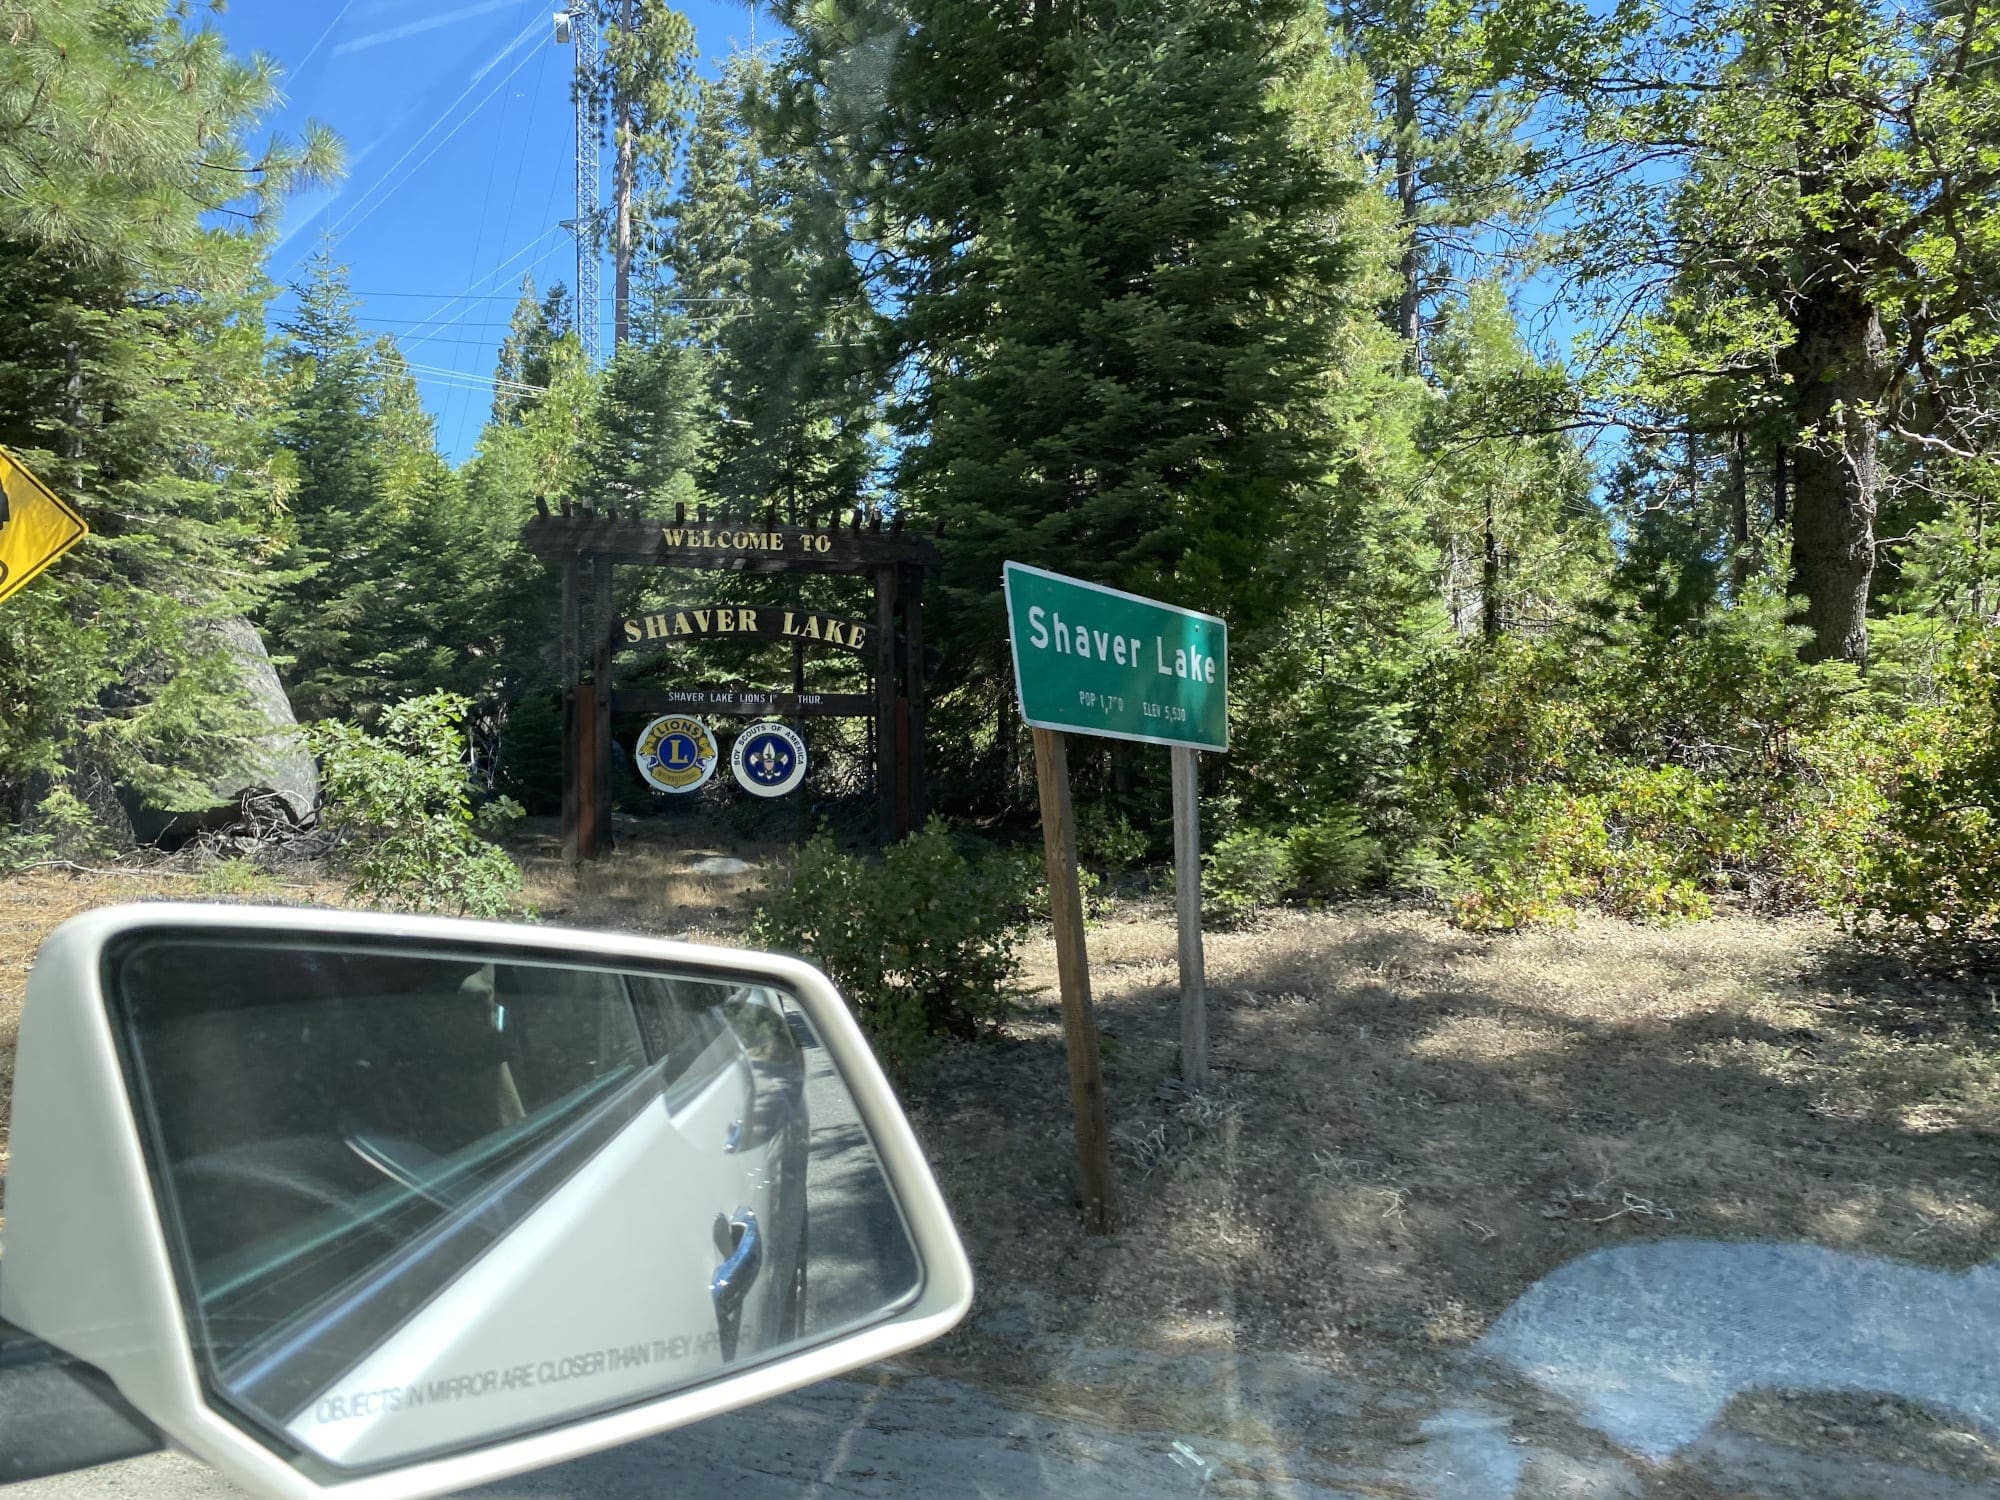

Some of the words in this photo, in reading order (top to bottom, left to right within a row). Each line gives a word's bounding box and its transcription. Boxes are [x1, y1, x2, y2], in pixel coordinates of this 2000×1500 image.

[662, 528, 784, 550] WELCOME
[800, 534, 832, 552] TO
[623, 609, 759, 643] SHAVER
[782, 612, 866, 650] LAKE
[1028, 605, 1141, 667] Shaver
[1156, 636, 1216, 684] Lake
[668, 691, 704, 702] SHAVER
[711, 693, 733, 703] LAKE
[740, 693, 766, 704] LIONS
[1079, 690, 1096, 707] POP
[1143, 702, 1161, 718] ELEV
[656, 720, 701, 736] LIONS
[669, 739, 689, 763] L
[733, 749, 741, 766] BOY
[738, 724, 767, 746] SCOUTS
[771, 724, 783, 732] OF
[784, 731, 804, 765] AMERICA
[315, 1386, 402, 1424] OBJECTS
[406, 1384, 424, 1409] IN
[427, 1369, 498, 1405] MIRROR
[501, 1362, 534, 1391] ARE
[537, 1348, 605, 1385] CLOSER
[607, 1342, 651, 1373] THAN
[652, 1334, 693, 1363] THEY
